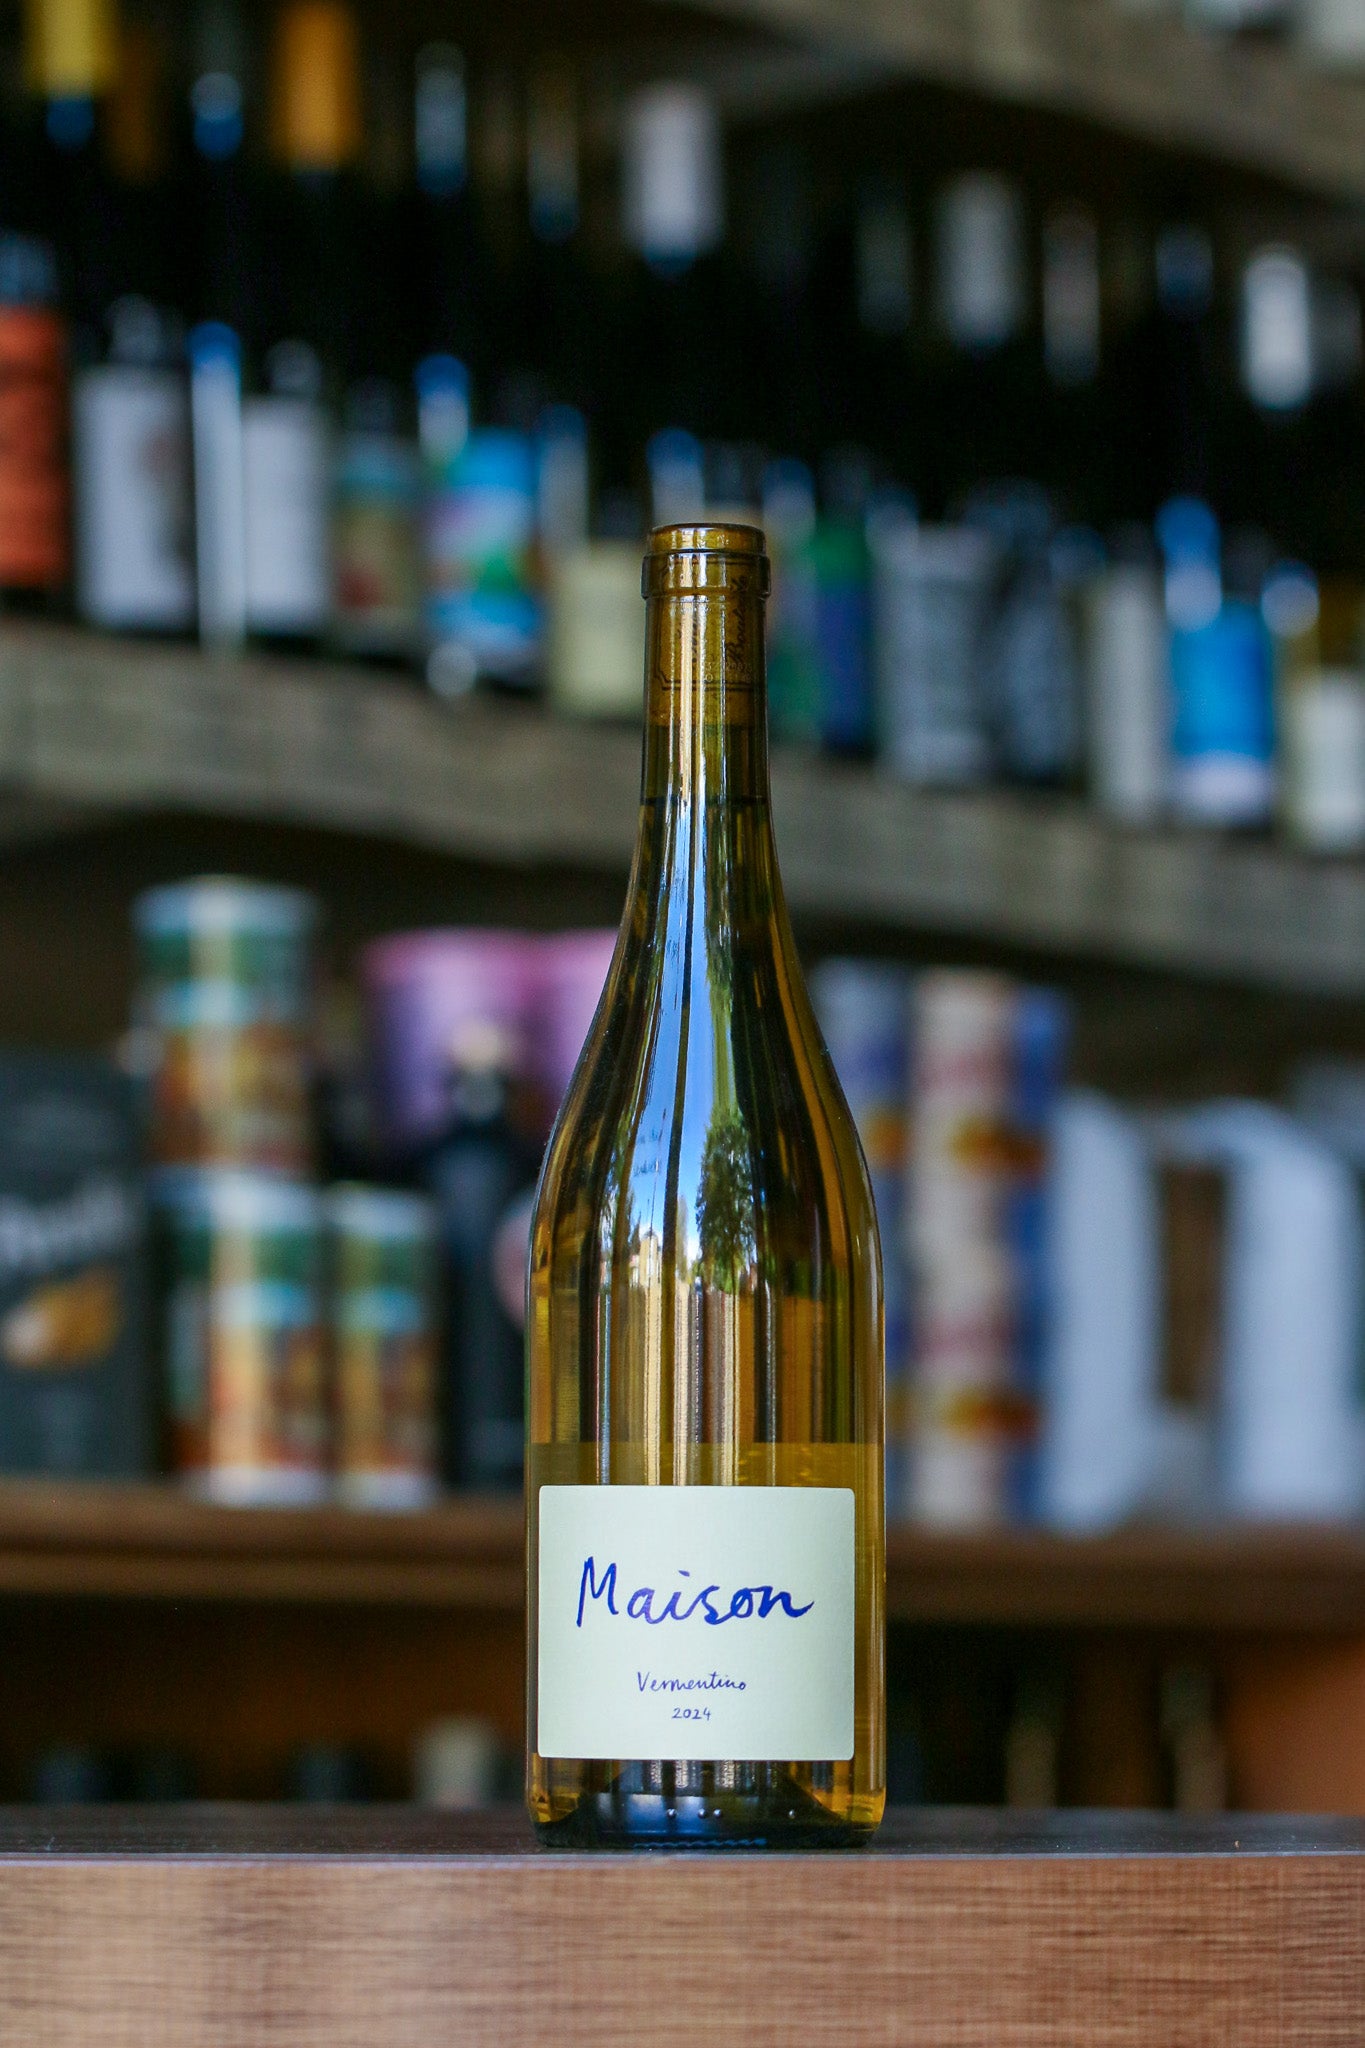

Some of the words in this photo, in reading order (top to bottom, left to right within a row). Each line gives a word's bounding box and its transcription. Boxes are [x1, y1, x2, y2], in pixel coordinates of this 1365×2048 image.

[576, 1556, 815, 1628] Maison
[637, 1671, 747, 1692] Vermentino
[671, 1707, 711, 1721] 2024
